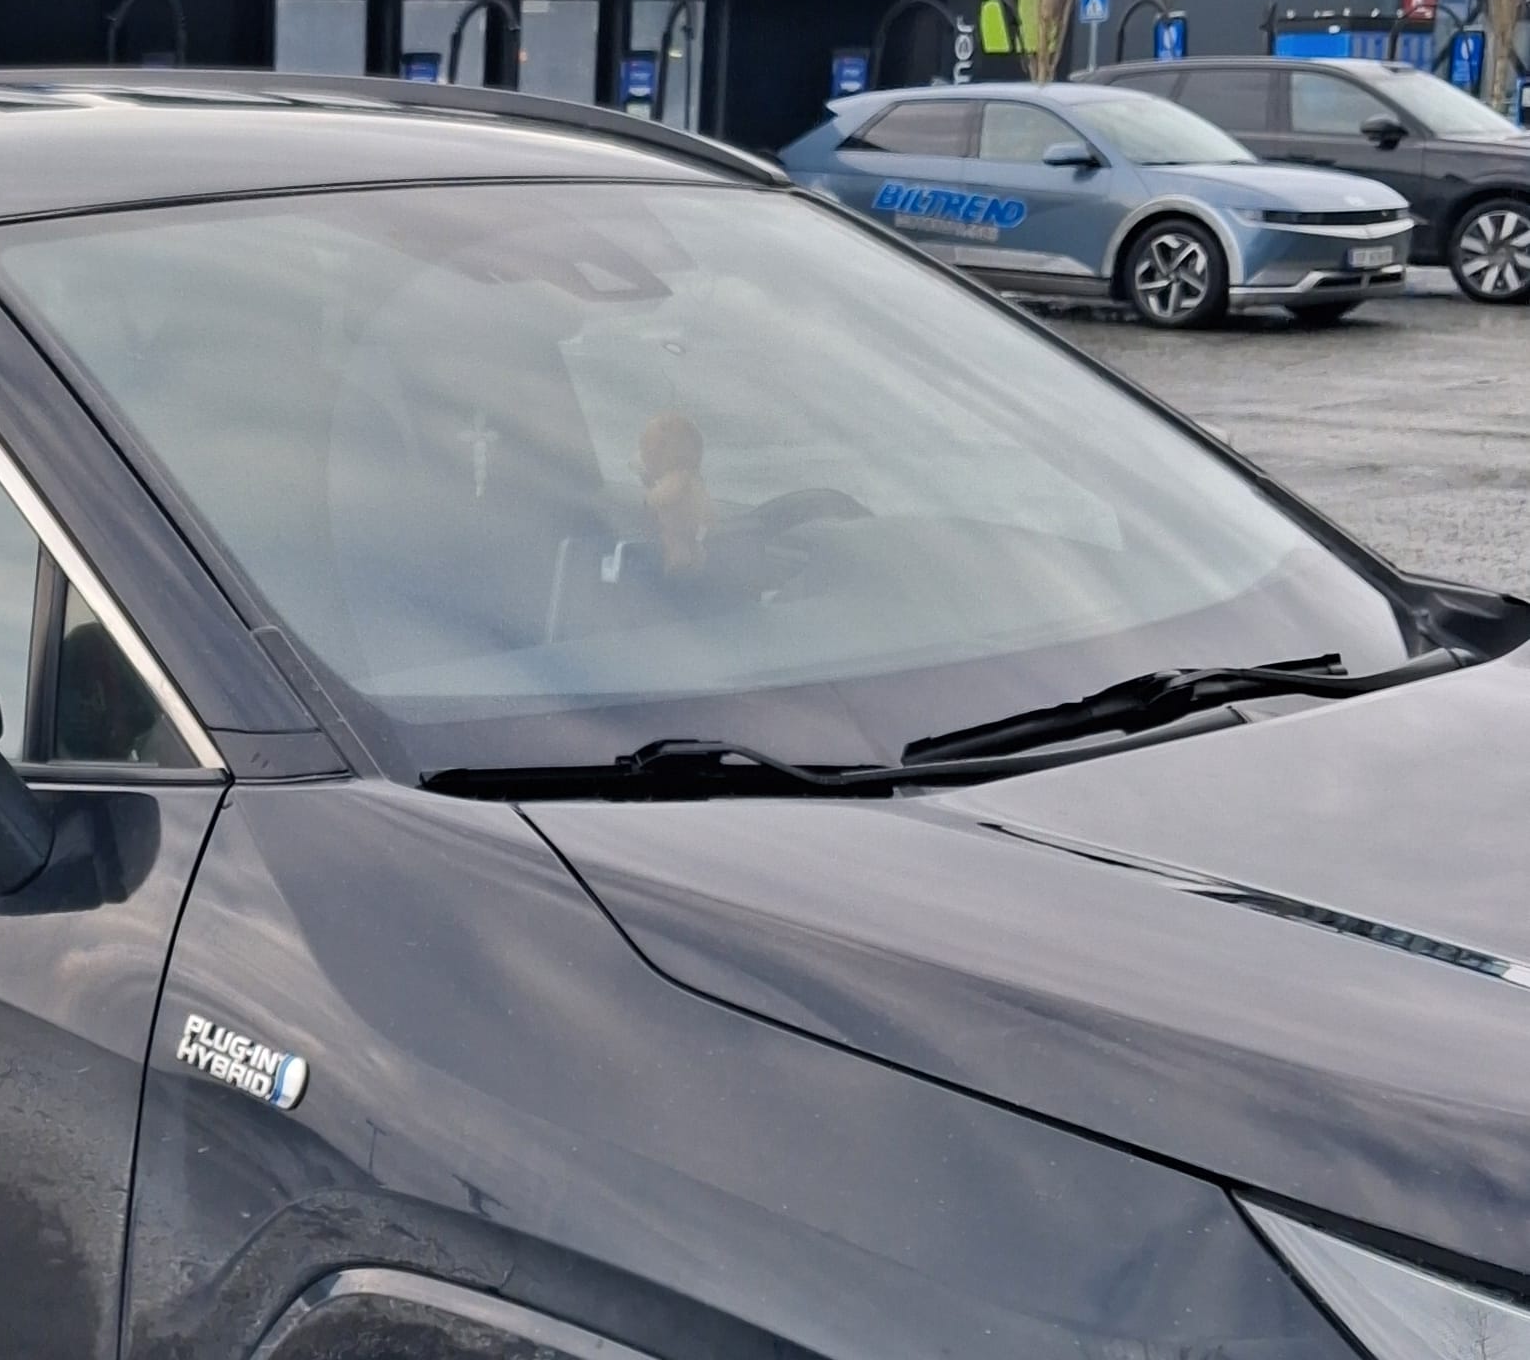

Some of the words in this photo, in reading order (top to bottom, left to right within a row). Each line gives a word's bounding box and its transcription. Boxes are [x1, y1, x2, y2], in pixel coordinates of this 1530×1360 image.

[872, 179, 1027, 229] BILTREND
[176, 1035, 273, 1099] HYBRID
[183, 1014, 280, 1075] PLUG-IN
